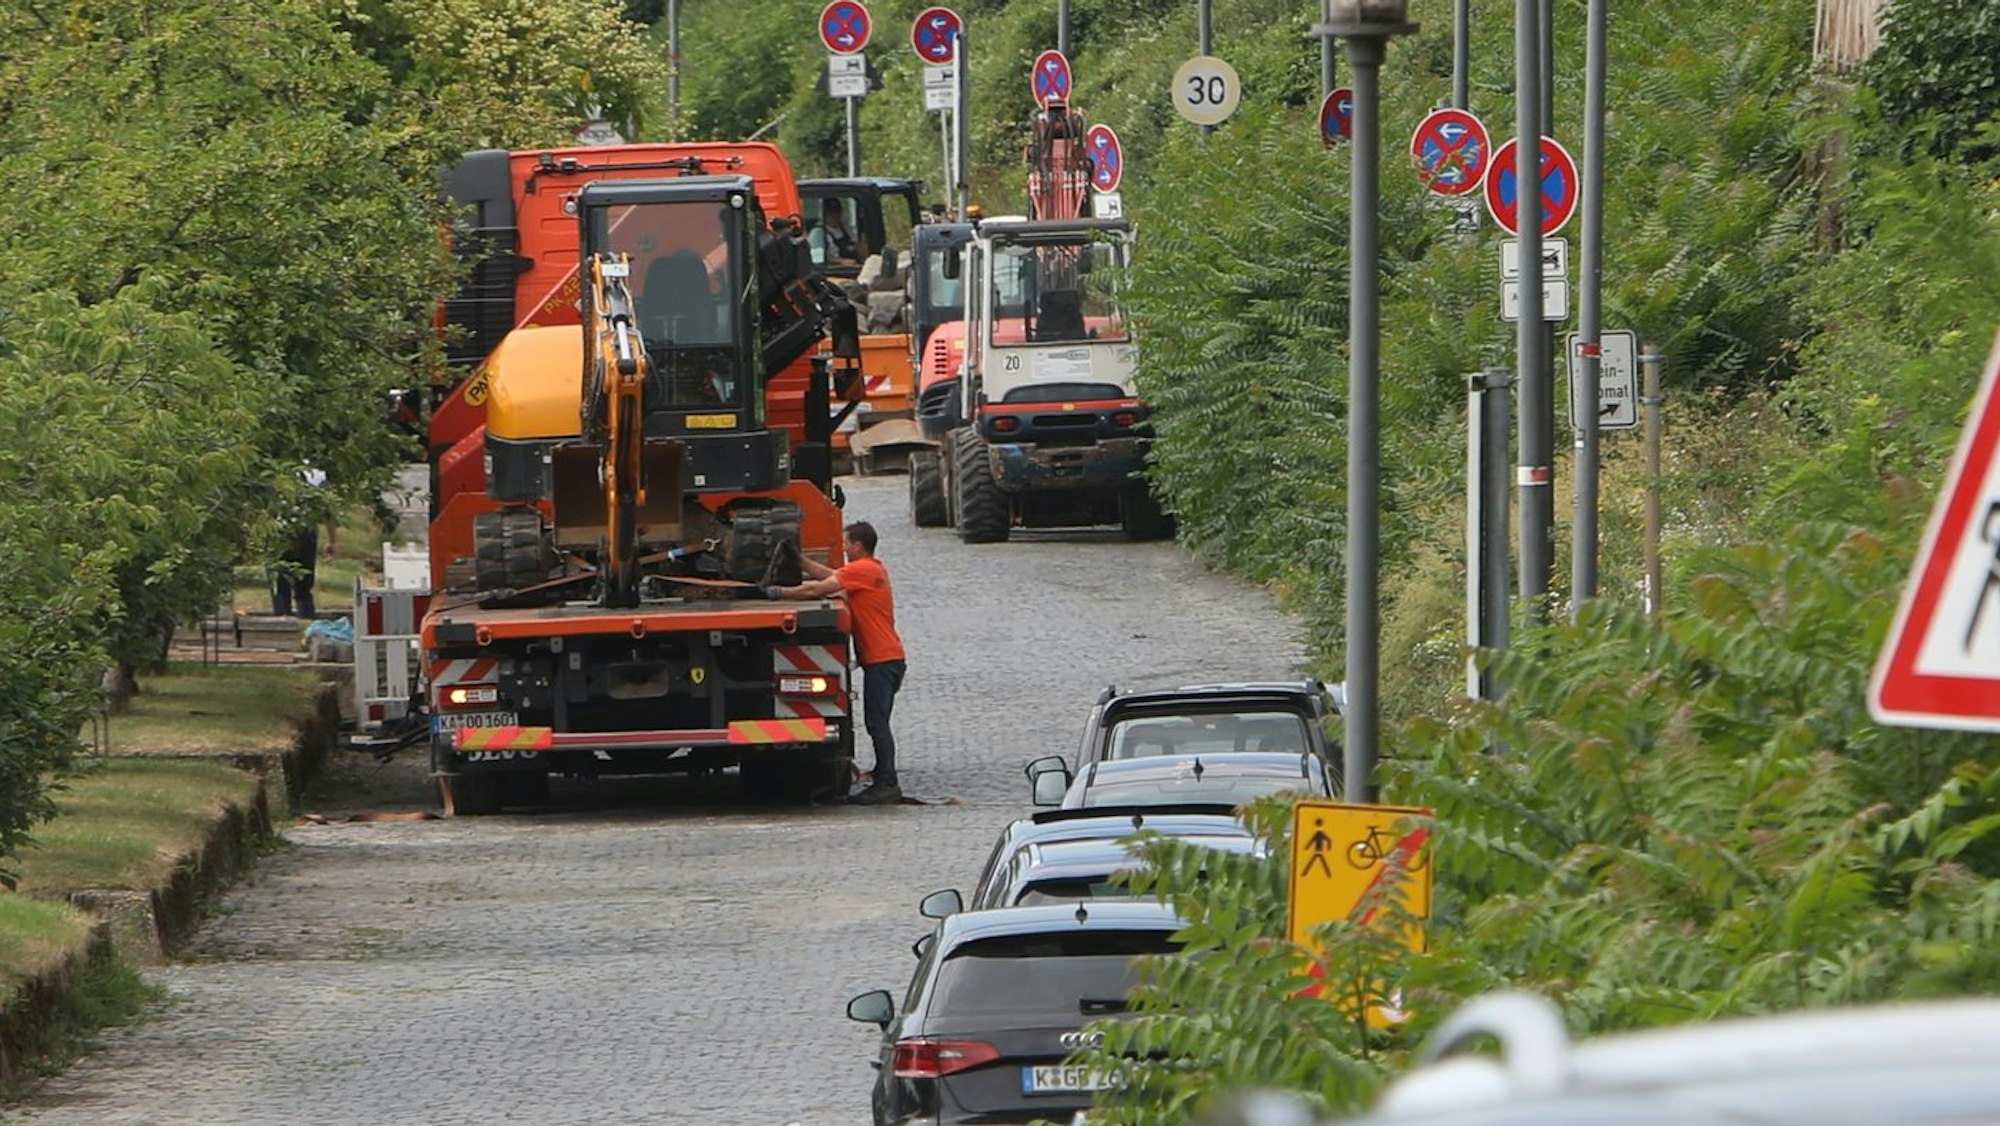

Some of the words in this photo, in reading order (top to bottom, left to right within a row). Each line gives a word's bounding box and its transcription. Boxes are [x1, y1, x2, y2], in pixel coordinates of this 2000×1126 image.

[1187, 76, 1225, 105] 30
[543, 295, 564, 315] PK
[1005, 355, 1020, 371] 20
[440, 716, 456, 729] KA
[1036, 1069, 1050, 1087] K
